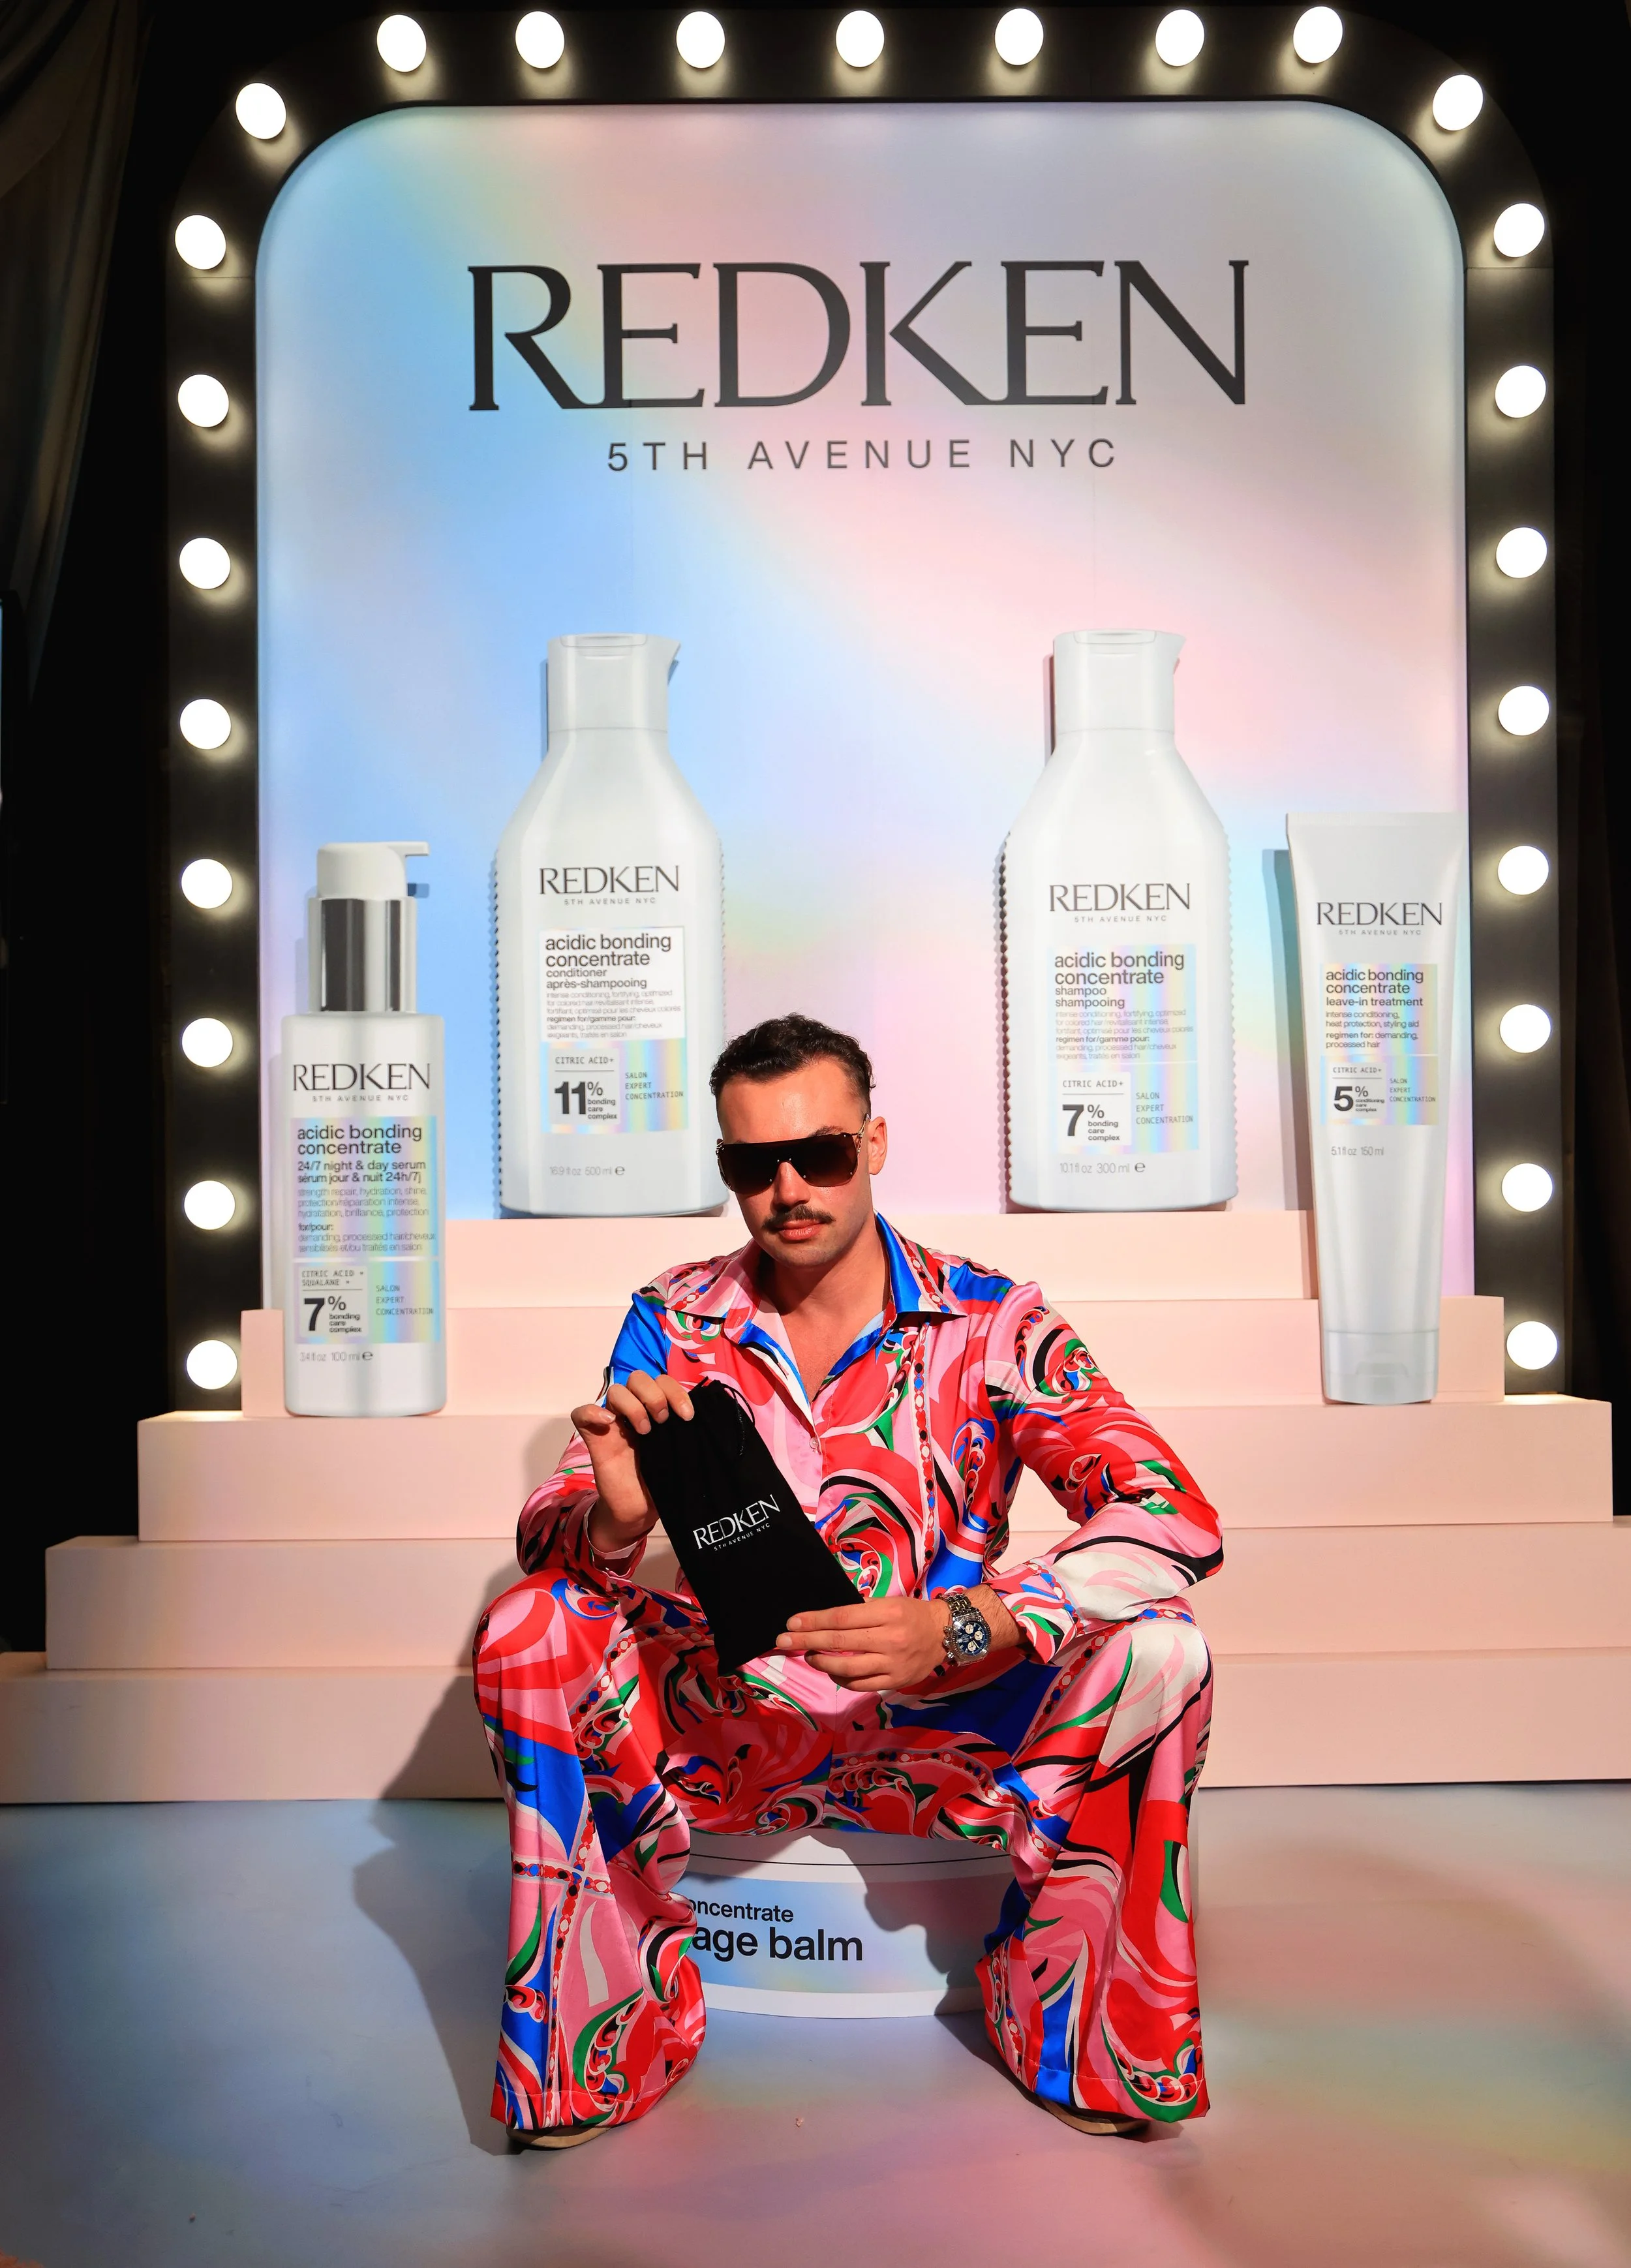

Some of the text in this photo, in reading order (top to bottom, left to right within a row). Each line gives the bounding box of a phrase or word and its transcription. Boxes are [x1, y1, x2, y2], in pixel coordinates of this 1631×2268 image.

[468, 260, 1249, 410] REDKEN
[607, 438, 1116, 470] 5TH AVENUE NYC
[539, 865, 679, 894] REDKEN
[1049, 883, 1191, 912] REDKEN
[1317, 902, 1442, 926] REDKEN
[545, 933, 671, 952] acidic bonding
[545, 951, 650, 967] concentrate
[1055, 951, 1185, 970] acidic bonding
[546, 968, 607, 977] conditioner
[1055, 969, 1165, 985] concentrate
[1326, 969, 1424, 983] acidic bonding
[546, 978, 647, 990] après-shampooing
[1055, 985, 1106, 997] shampoo
[1326, 983, 1410, 994] concentrate
[1055, 997, 1125, 1009] shampooing
[1326, 997, 1423, 1006] leave-in treatment
[1326, 1032, 1359, 1040] regimen
[555, 1056, 585, 1065] CITRIC
[292, 1063, 431, 1091] REDKEN
[625, 1091, 684, 1100] CONCENTRATION
[1136, 1115, 1193, 1125] CONCENTRATION
[297, 1124, 422, 1142] acidic bonding
[297, 1141, 401, 1154] concentrate
[297, 1160, 426, 1172] 24/7 night & day serum
[1097, 1163, 1116, 1173] 300
[1118, 1163, 1130, 1172] ml
[328, 1173, 349, 1184] jour
[352, 1173, 360, 1182] &
[363, 1172, 382, 1182] nuit
[693, 1494, 780, 1550] REDKEN
[728, 1531, 754, 1546] AVENUE
[756, 1522, 770, 1533] NYC
[769, 1926, 863, 1961] balm
